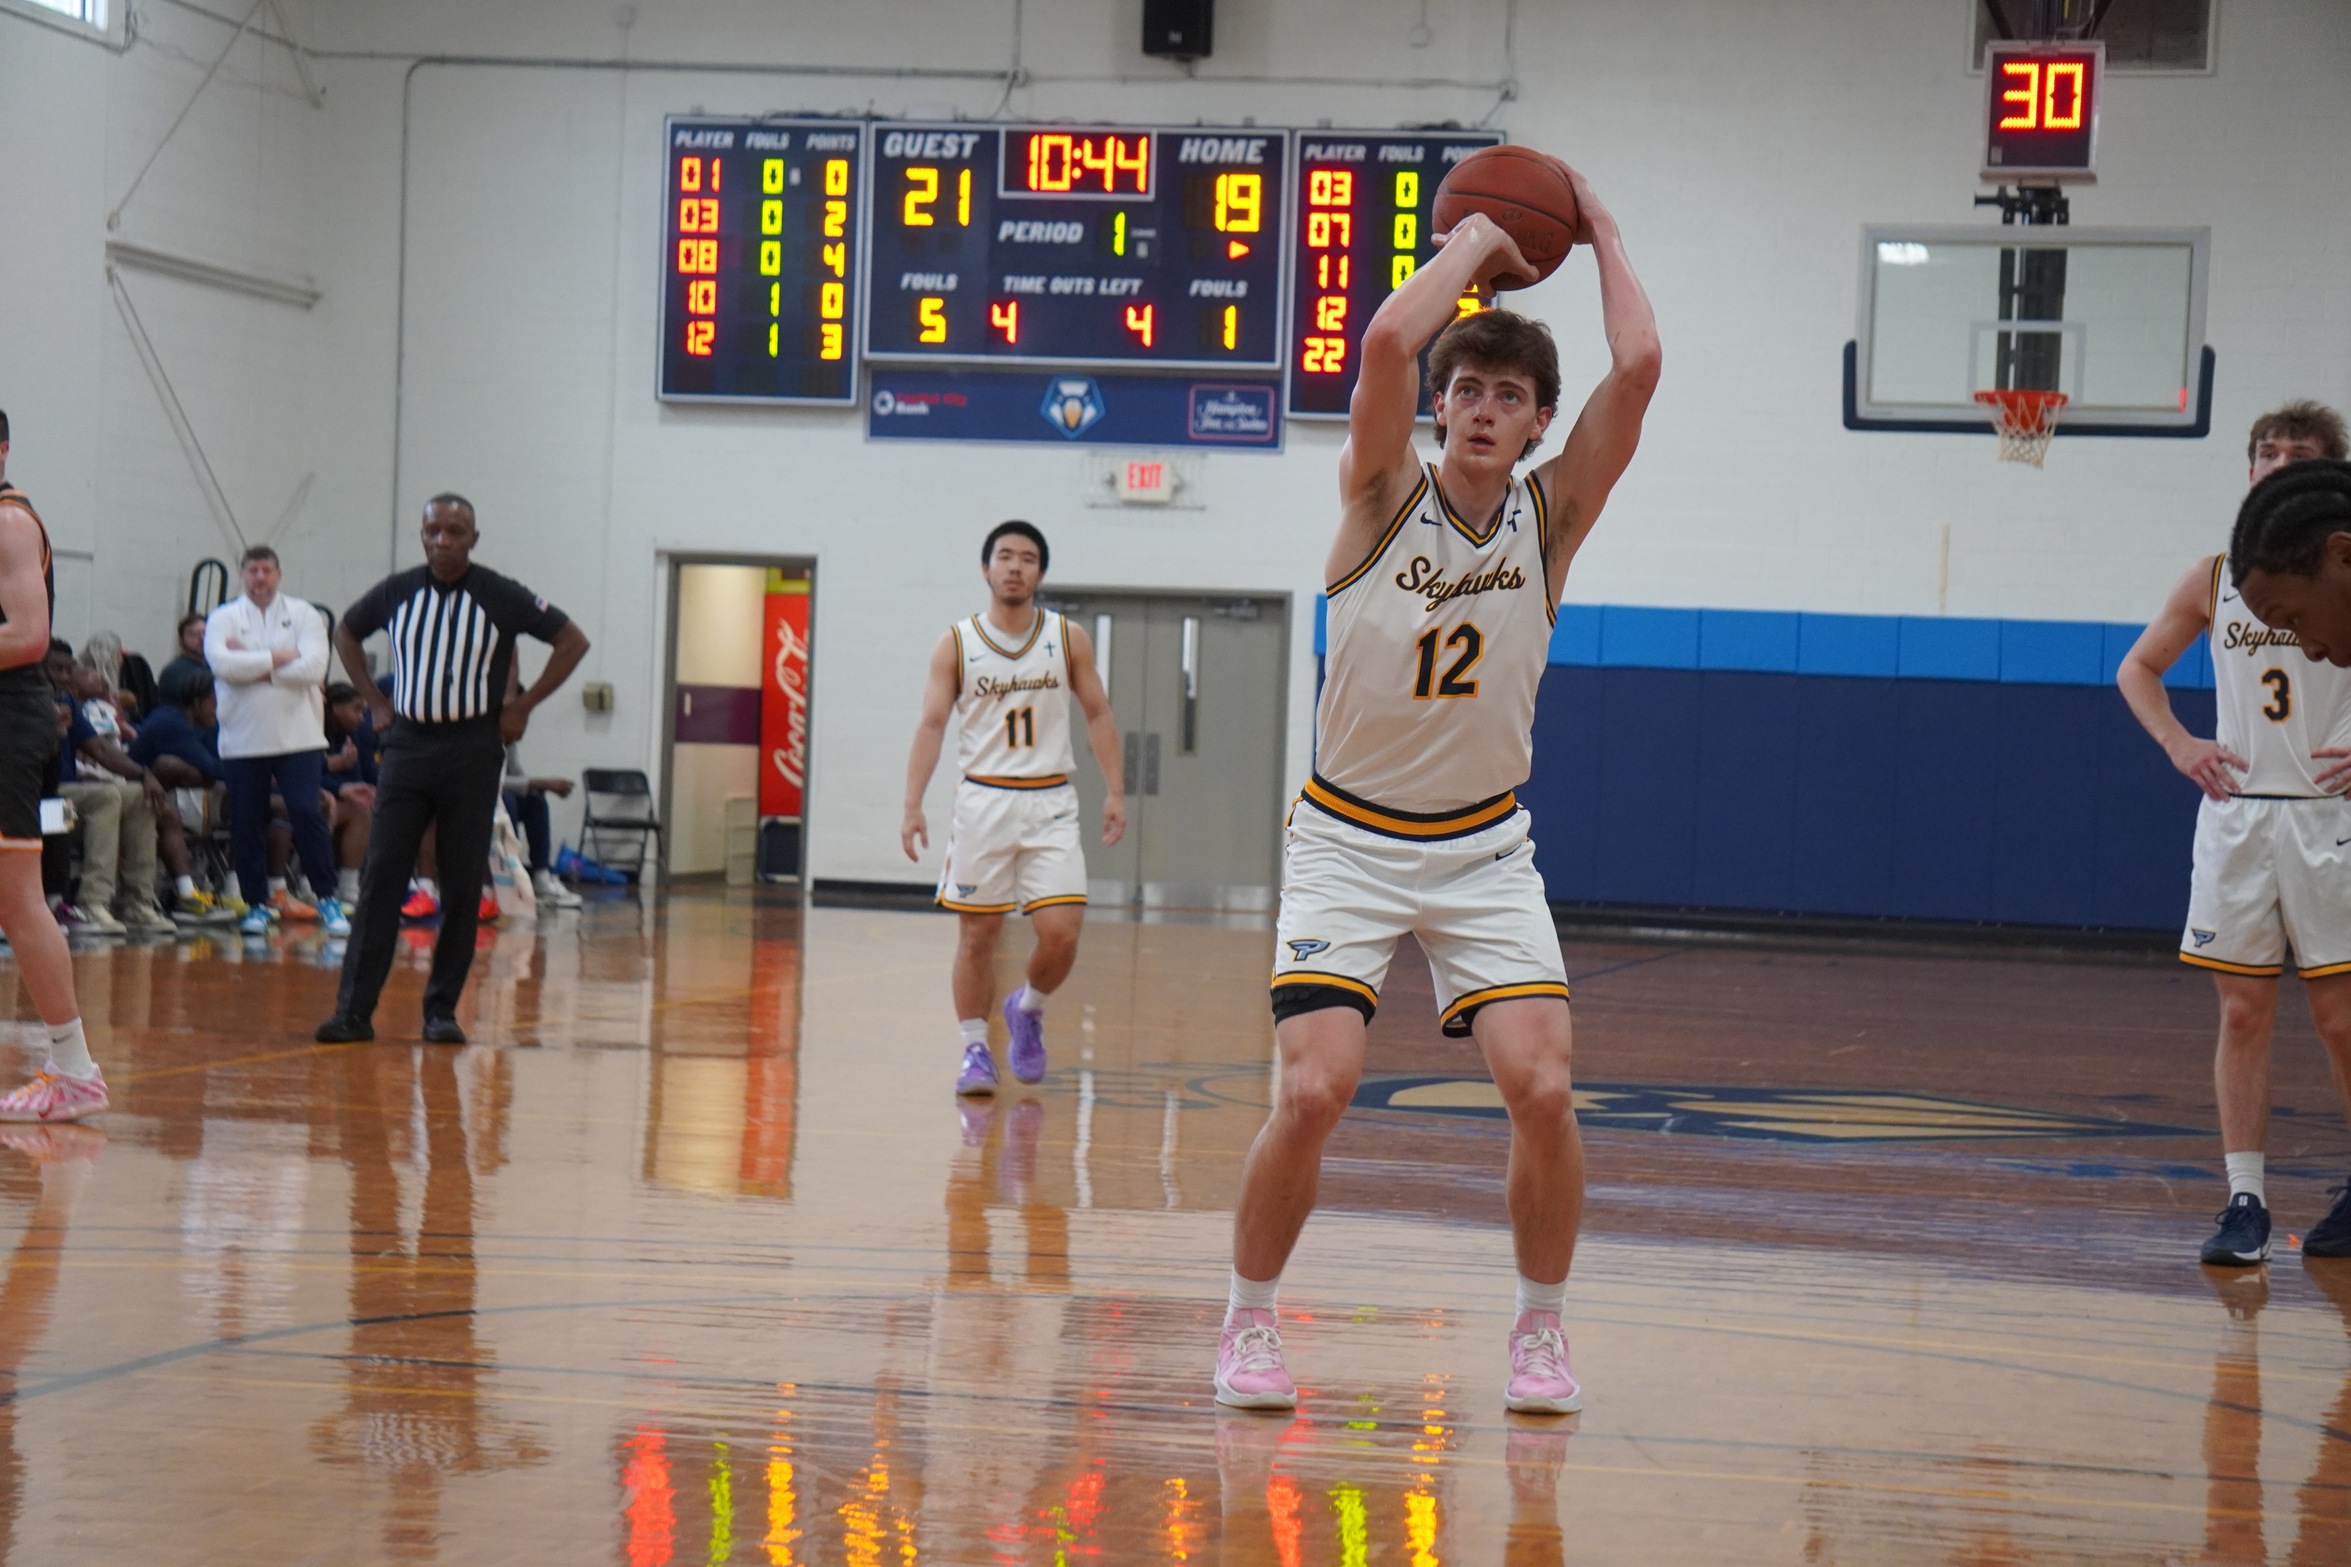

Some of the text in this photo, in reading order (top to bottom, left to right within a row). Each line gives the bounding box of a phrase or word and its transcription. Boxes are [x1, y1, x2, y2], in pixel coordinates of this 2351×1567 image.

[1999, 62, 2084, 129] 30
[674, 130, 857, 151] PLAYER FOULS POINTS
[883, 131, 980, 159] GUEST
[1178, 137, 1268, 164] HOME
[1304, 143, 1367, 162] PLAYER
[1378, 144, 1426, 163] FOULS
[680, 157, 849, 196] 01 0 0
[1027, 133, 1149, 193] 10:44
[904, 168, 971, 227] 21
[1214, 173, 1262, 233] 19
[1309, 170, 1419, 208] 03 0
[679, 198, 847, 238] 03 0 2
[998, 220, 1085, 244] PERIOD
[1113, 211, 1126, 256] 1
[1307, 212, 1417, 250] 07 0
[677, 239, 845, 278] 08 0 4
[1317, 253, 1416, 290] 11 0
[687, 280, 844, 319] 10 1 0
[900, 272, 958, 291] FOULS
[1003, 275, 1144, 296] TIME OUTS LEFT
[1189, 279, 1249, 298] FOULS
[919, 297, 947, 343] 5
[991, 301, 1018, 345] 4
[1125, 304, 1153, 348] 4
[1223, 305, 1237, 350] 1
[1316, 295, 1348, 332] 12
[686, 321, 843, 360] 12 1 3
[1303, 337, 1346, 373] 22
[1127, 462, 1165, 491] EXIT
[1396, 556, 1526, 612] Skyhawks
[1412, 621, 1484, 700] 12
[975, 670, 1060, 702] Skyhawks
[2261, 667, 2292, 723] 3
[1005, 705, 1035, 749] 11
